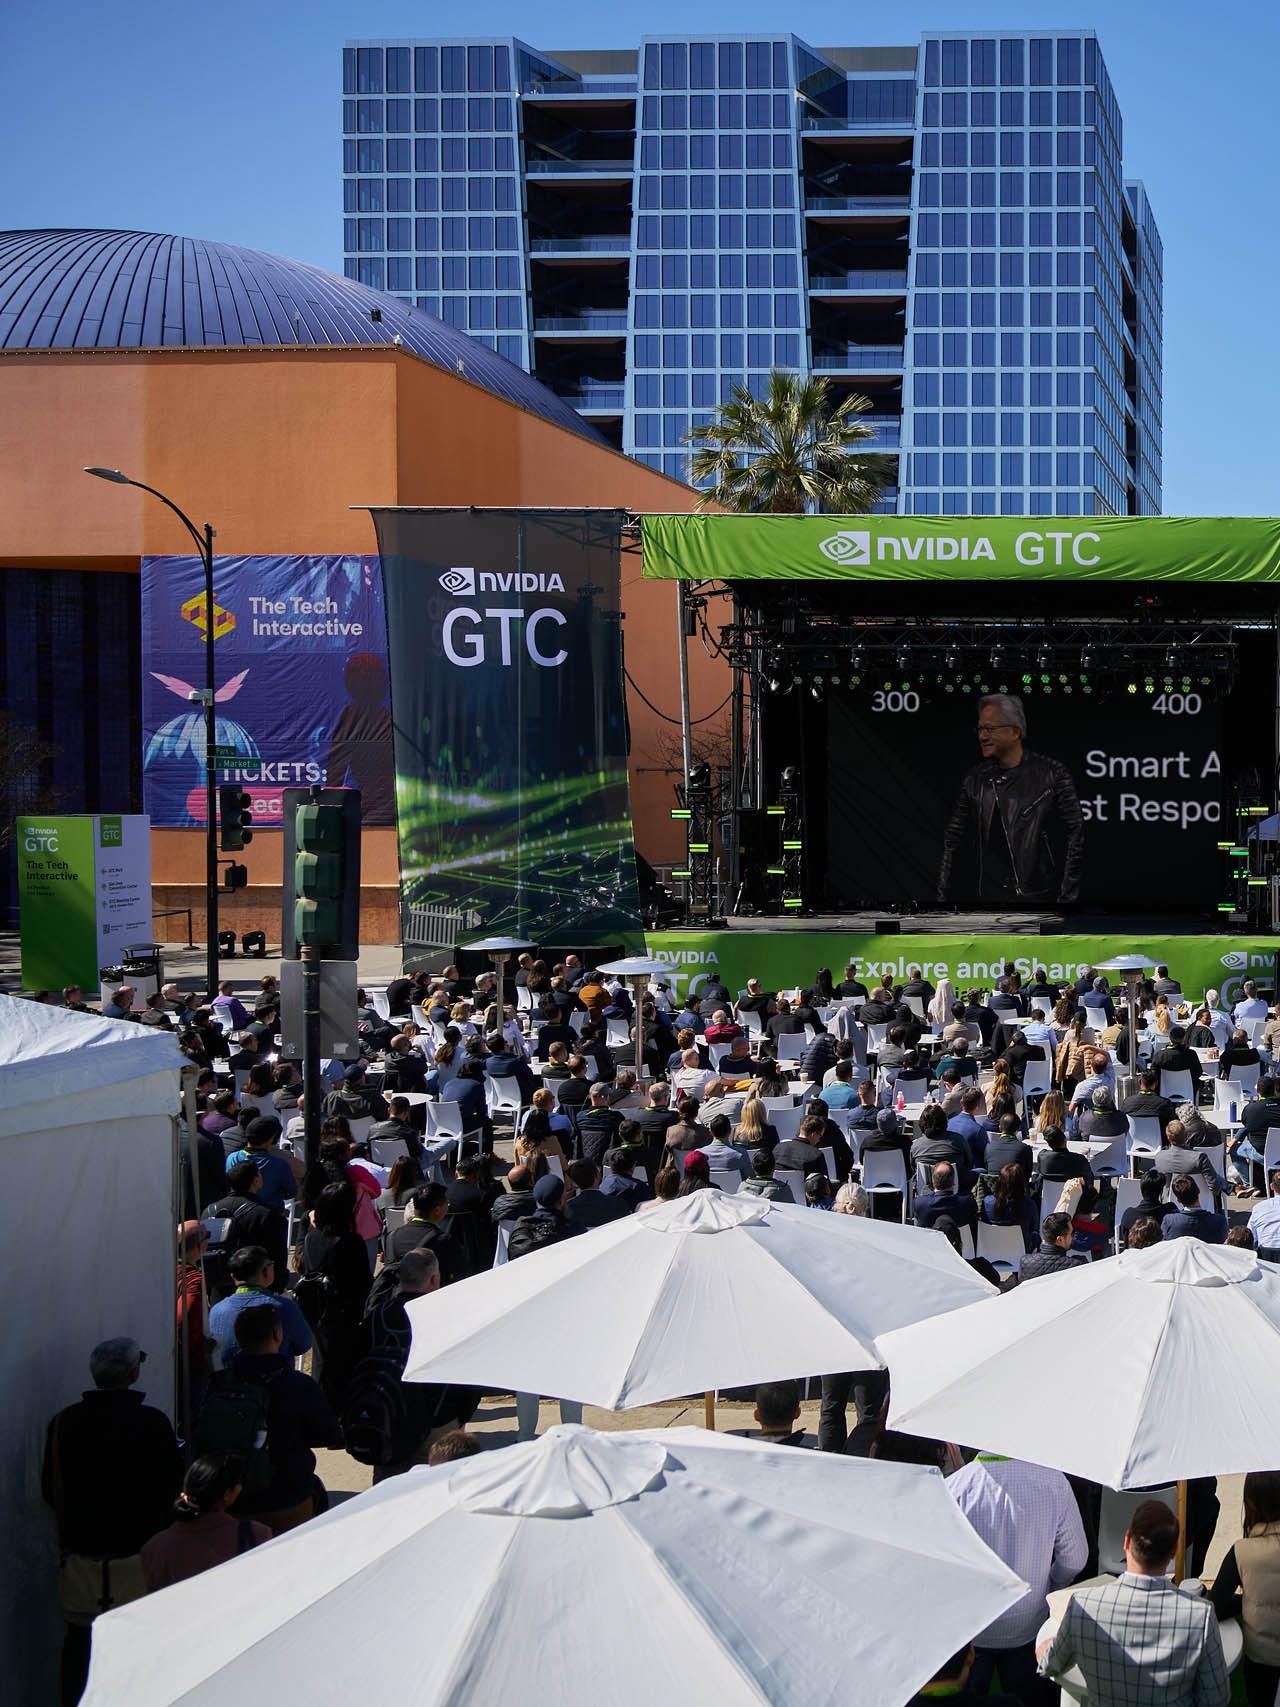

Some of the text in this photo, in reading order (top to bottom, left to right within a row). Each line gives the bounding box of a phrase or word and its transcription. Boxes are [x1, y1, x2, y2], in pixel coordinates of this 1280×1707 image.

[1015, 532, 1101, 566] GTC
[248, 597, 338, 615] The Tech
[253, 618, 363, 636] Interactive
[442, 607, 569, 667] GTC
[871, 691, 1201, 715] 300 400
[223, 759, 250, 768] Market
[1086, 750, 1191, 778] Smart
[24, 837, 59, 852] GTC
[27, 861, 69, 870] The Tech
[26, 872, 79, 881] Interactive
[956, 956, 1006, 980] and
